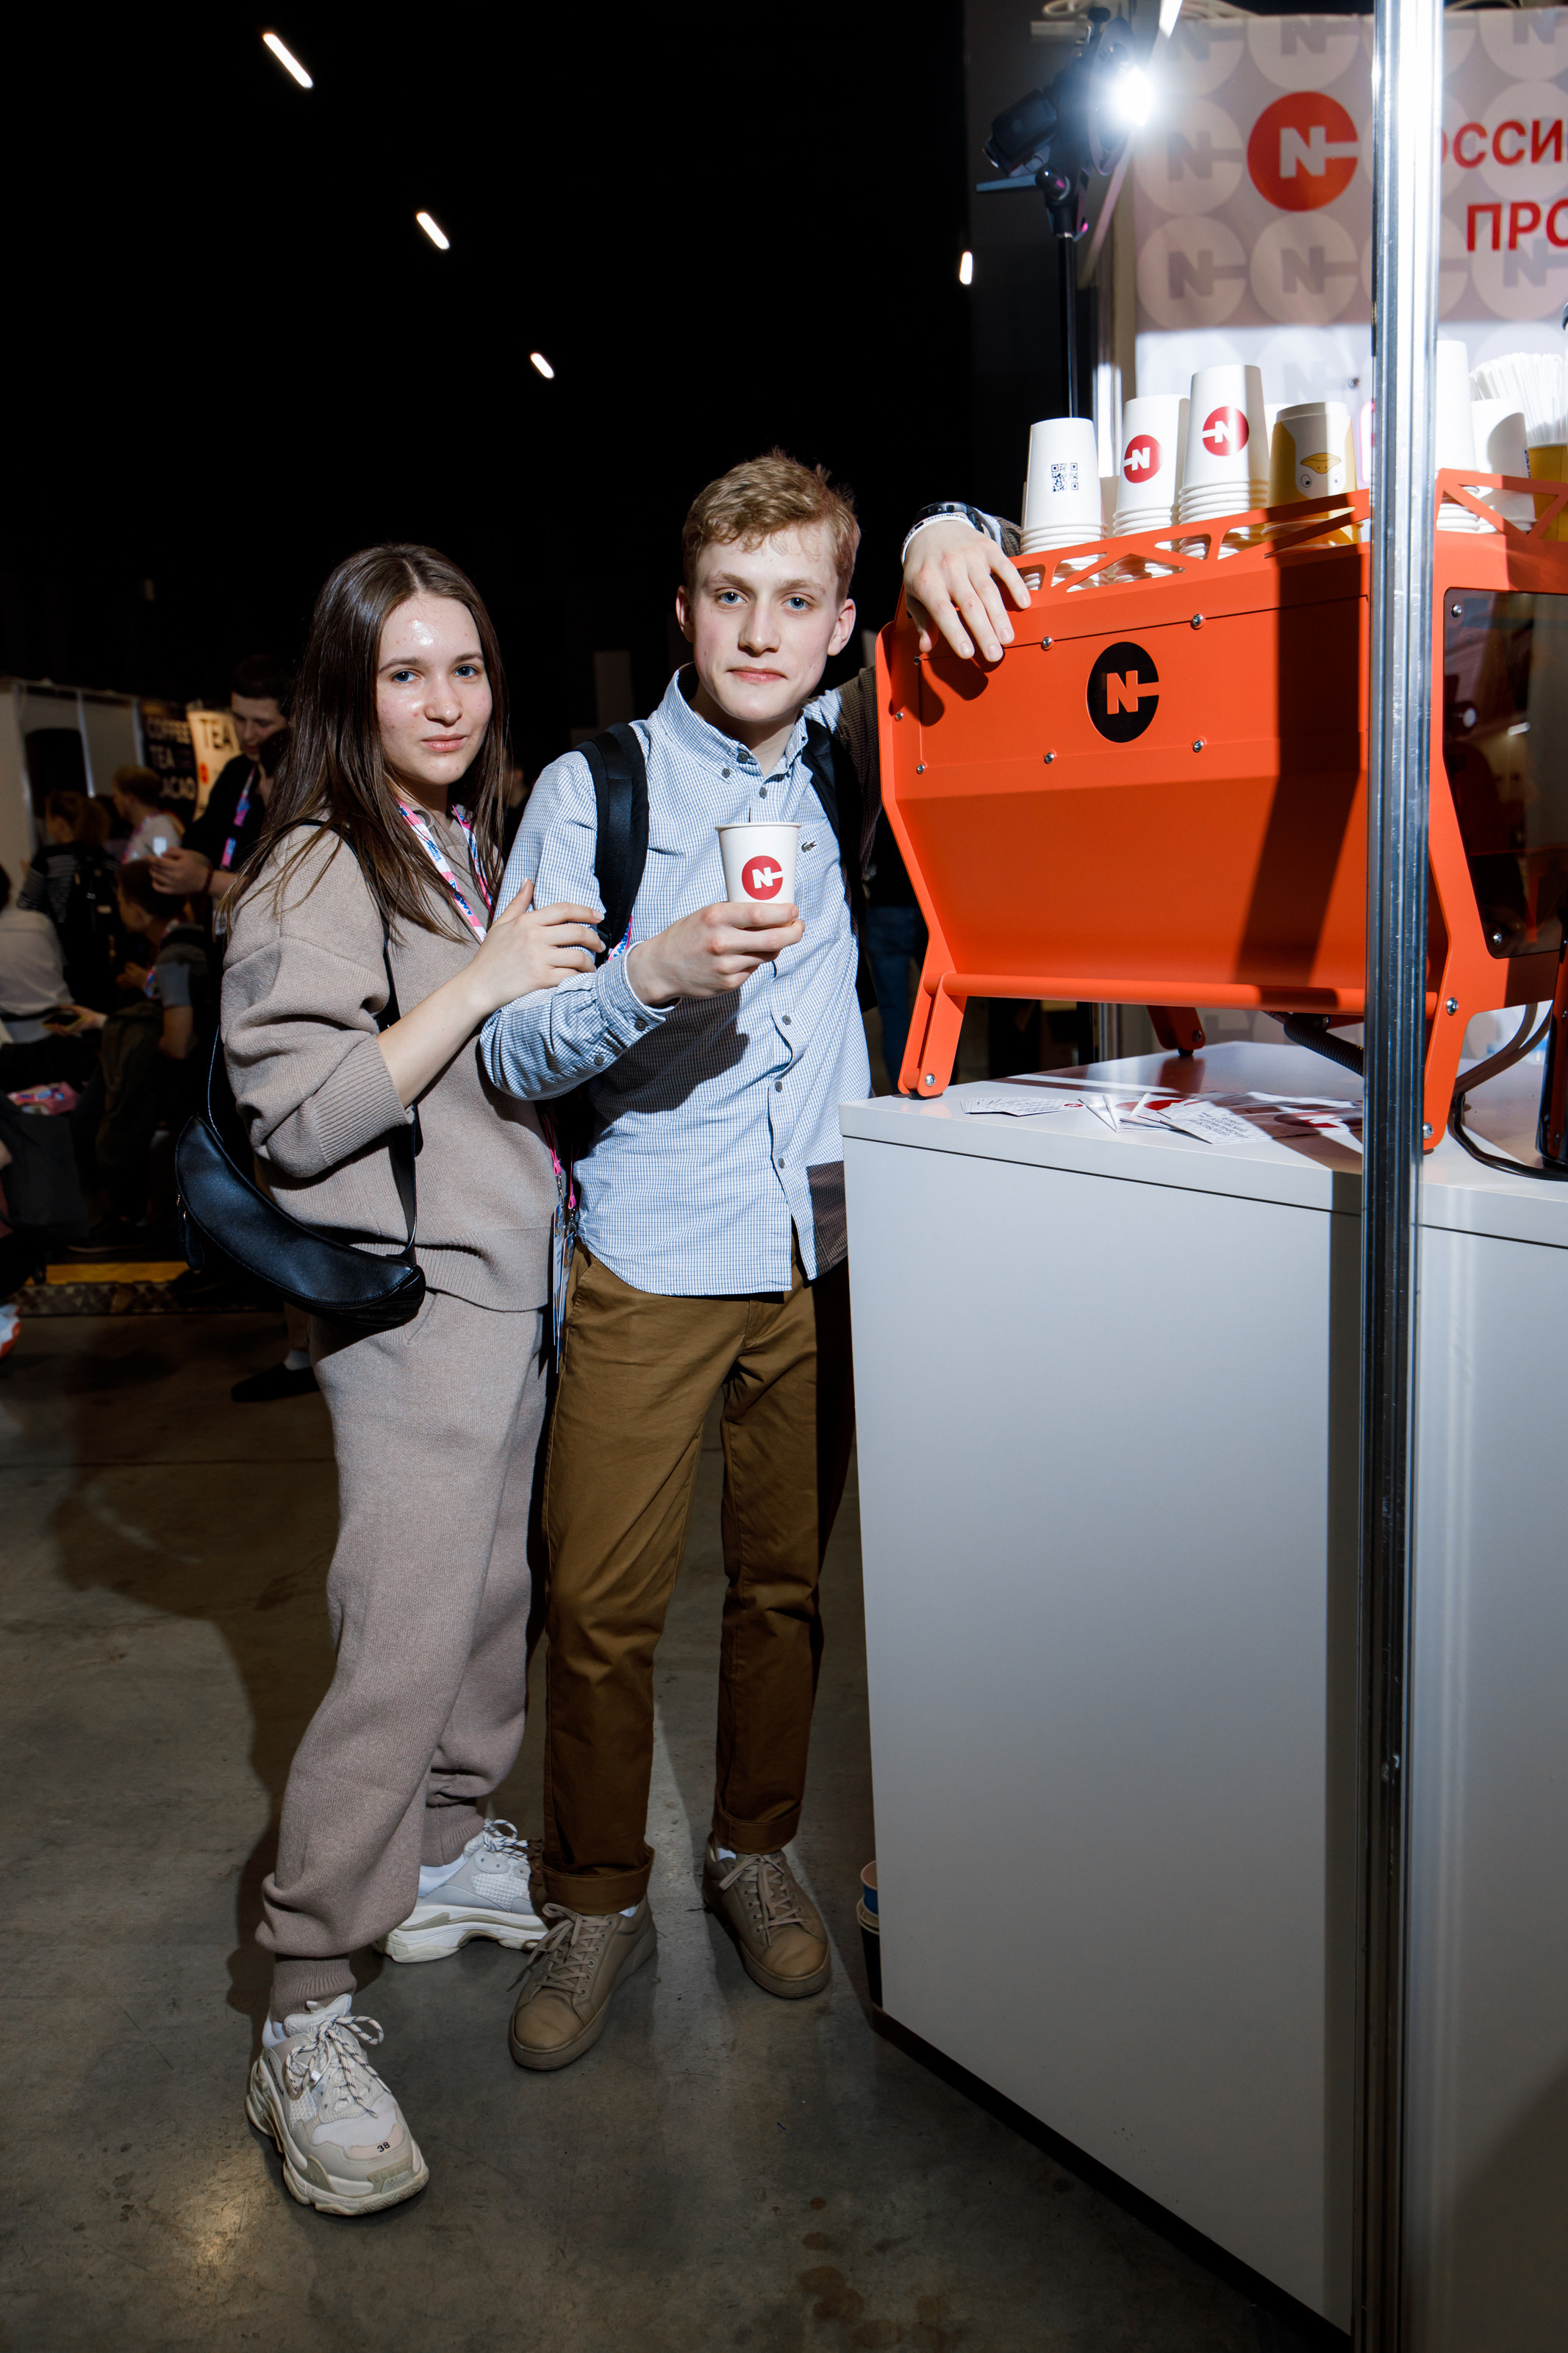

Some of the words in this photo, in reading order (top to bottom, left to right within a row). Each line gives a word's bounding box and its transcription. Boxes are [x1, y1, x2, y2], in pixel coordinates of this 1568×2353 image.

[1442, 119, 1568, 168] ССИ
[199, 718, 235, 751] TEA
[377, 2141, 390, 2152] 38
